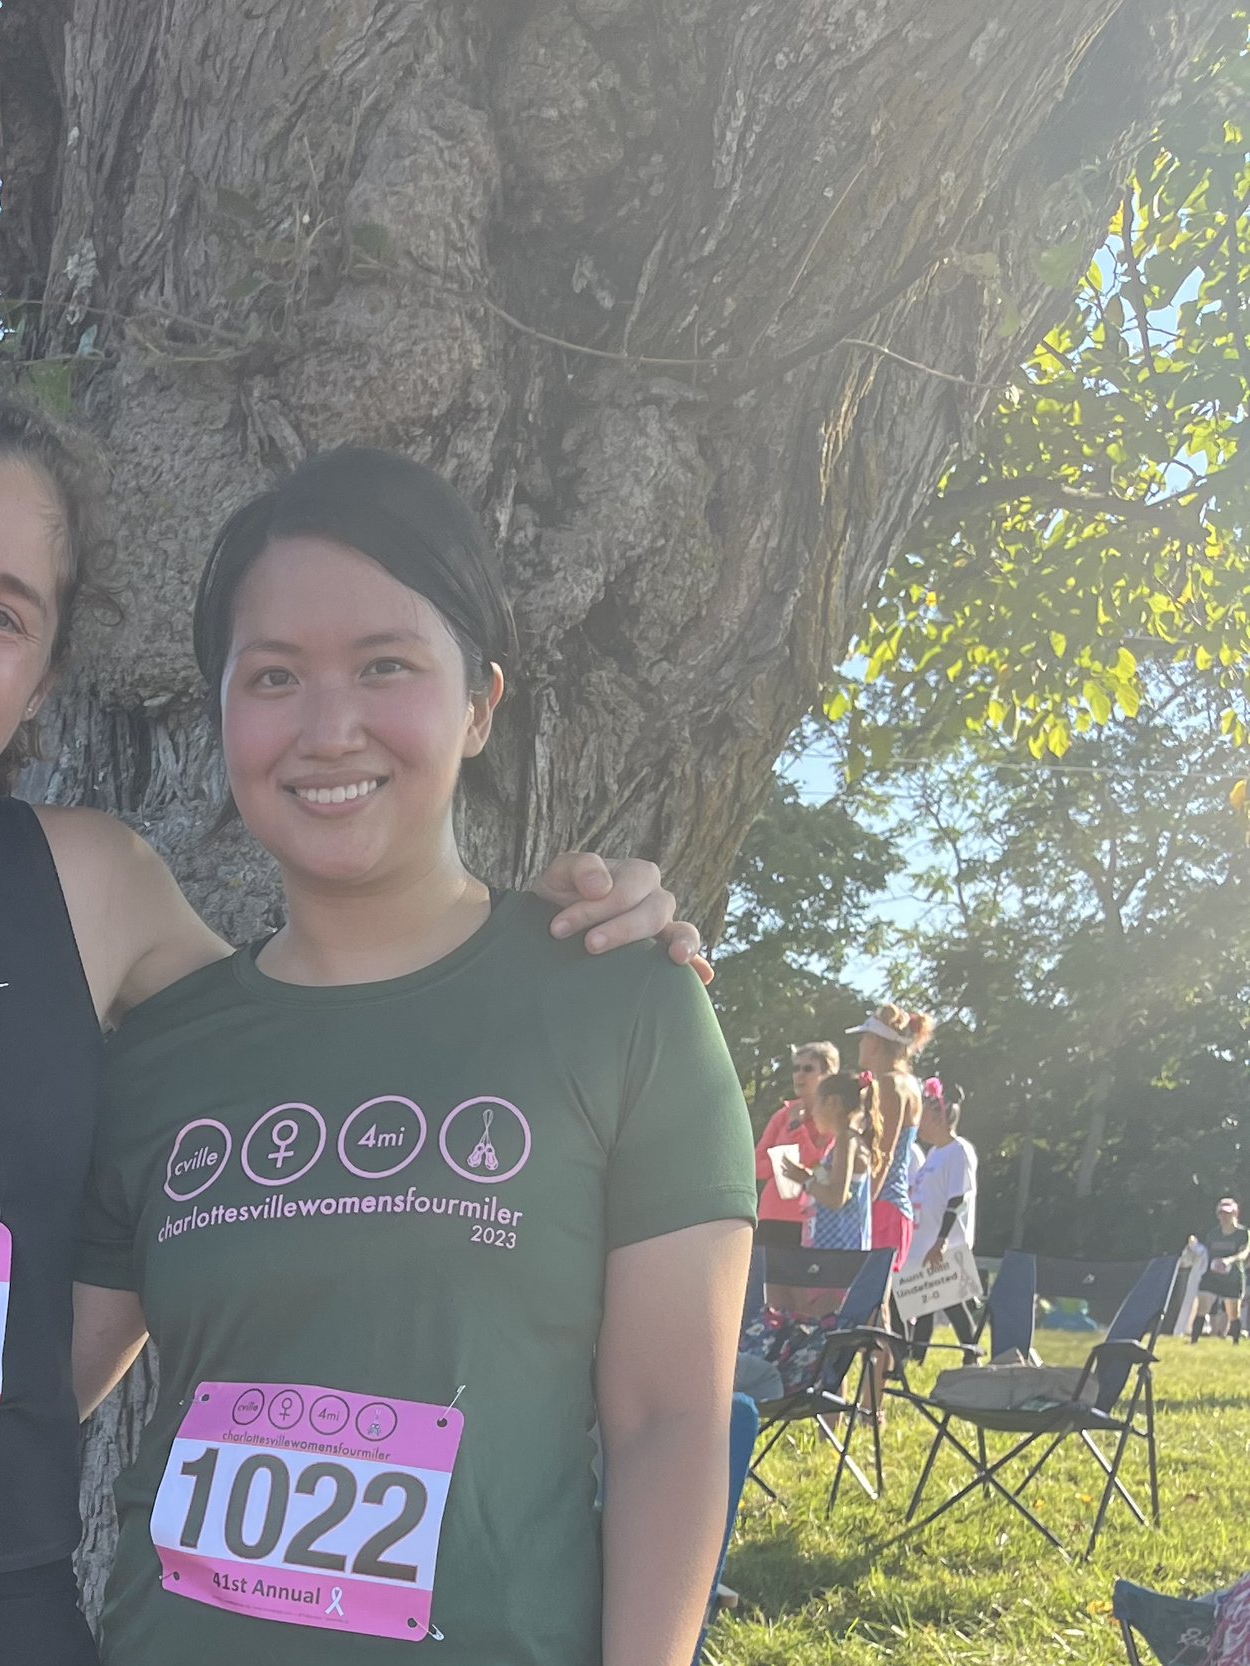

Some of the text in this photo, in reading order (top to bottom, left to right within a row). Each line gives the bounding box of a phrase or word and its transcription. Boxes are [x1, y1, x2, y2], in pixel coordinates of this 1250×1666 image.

[358, 1122, 405, 1149] 4mi
[174, 1145, 218, 1176] cville
[157, 1186, 523, 1243] charlottesvillewomensfourmiler
[470, 1224, 517, 1249] 2023
[237, 1401, 259, 1412] cville
[318, 1408, 340, 1422] 4mi
[222, 1430, 391, 1461] charlottesvillewomensfourmiler
[179, 1446, 428, 1583] 1022
[212, 1572, 321, 1605] 41st Annual
